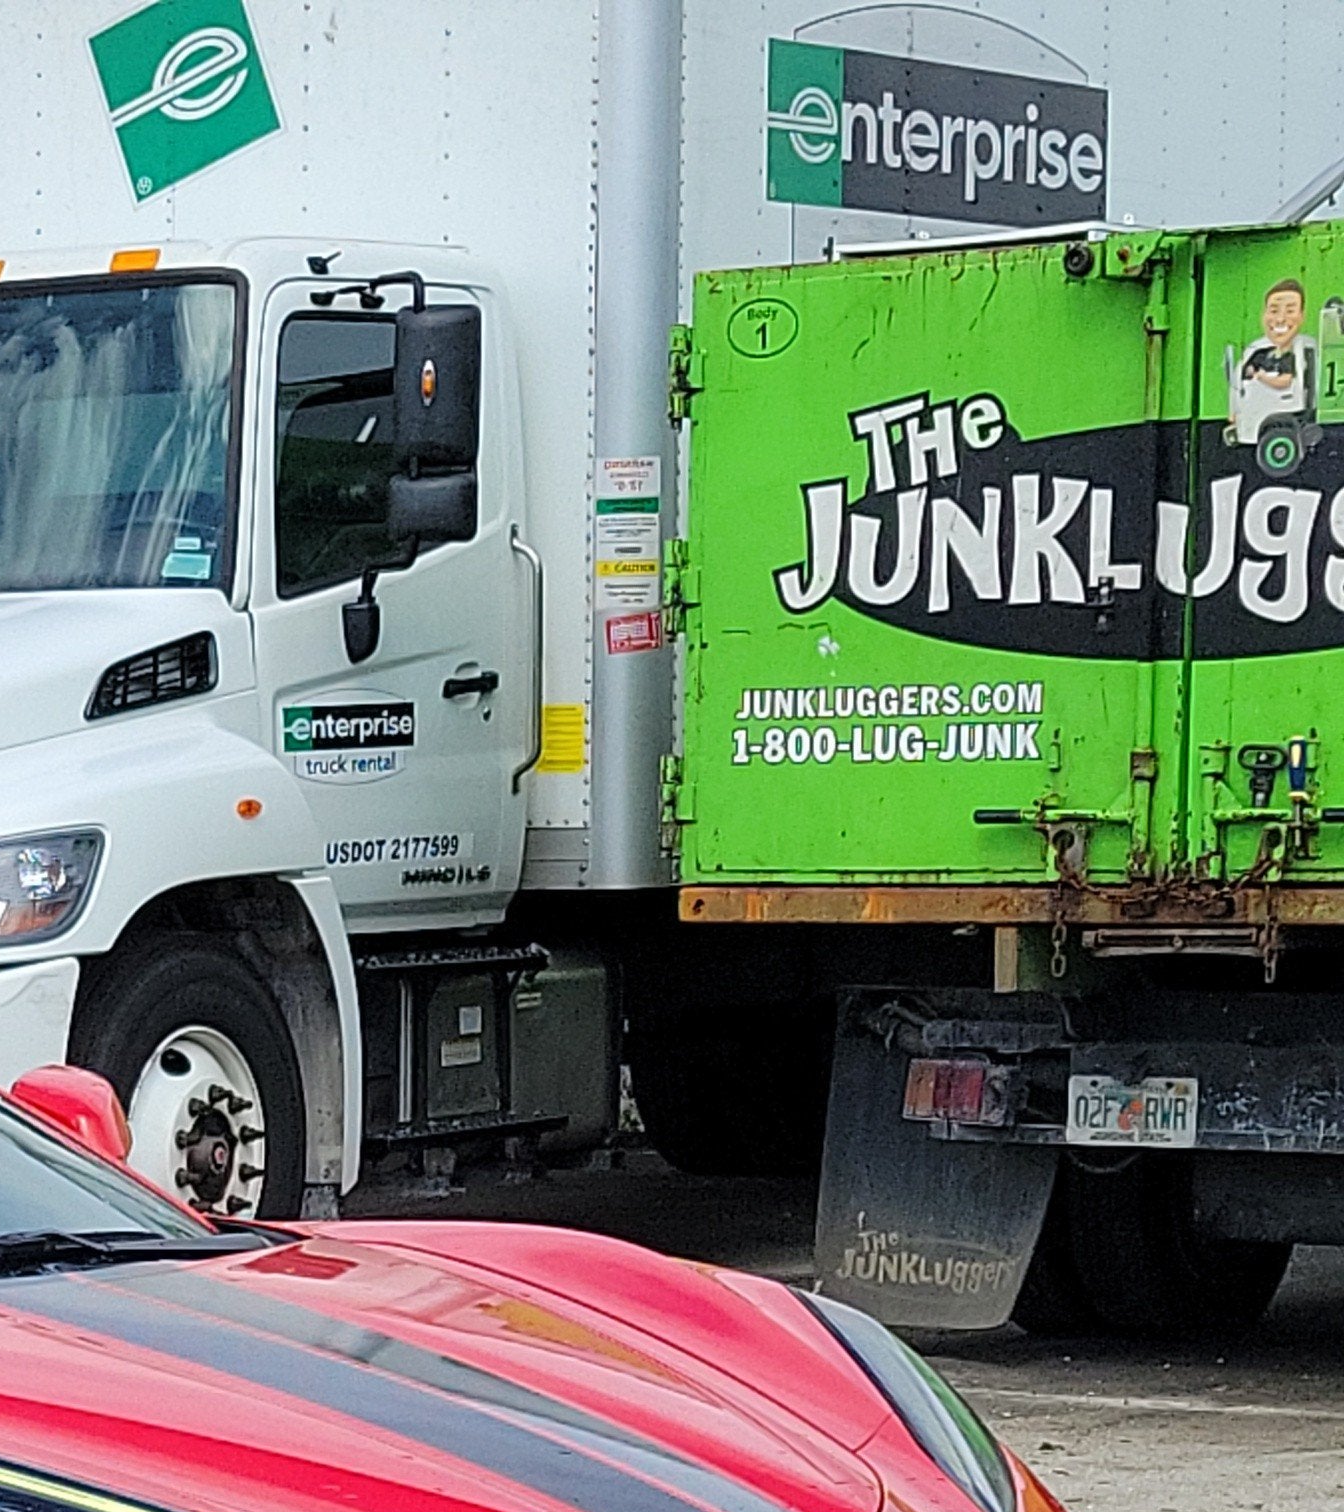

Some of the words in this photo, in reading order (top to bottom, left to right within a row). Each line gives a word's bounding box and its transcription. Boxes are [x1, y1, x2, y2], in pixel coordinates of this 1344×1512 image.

[767, 86, 1104, 202] enterprise
[755, 322, 767, 350] 1
[777, 473, 1344, 624] JUNKLUg
[735, 681, 1043, 720] JUNKLUGGERS.COM
[283, 710, 413, 744] enterprise
[732, 722, 1041, 764] 1-800-LUG-JUNK
[306, 754, 347, 775] truck
[352, 751, 396, 773] rental
[326, 840, 386, 864] USDOT
[390, 835, 459, 861] 2177599
